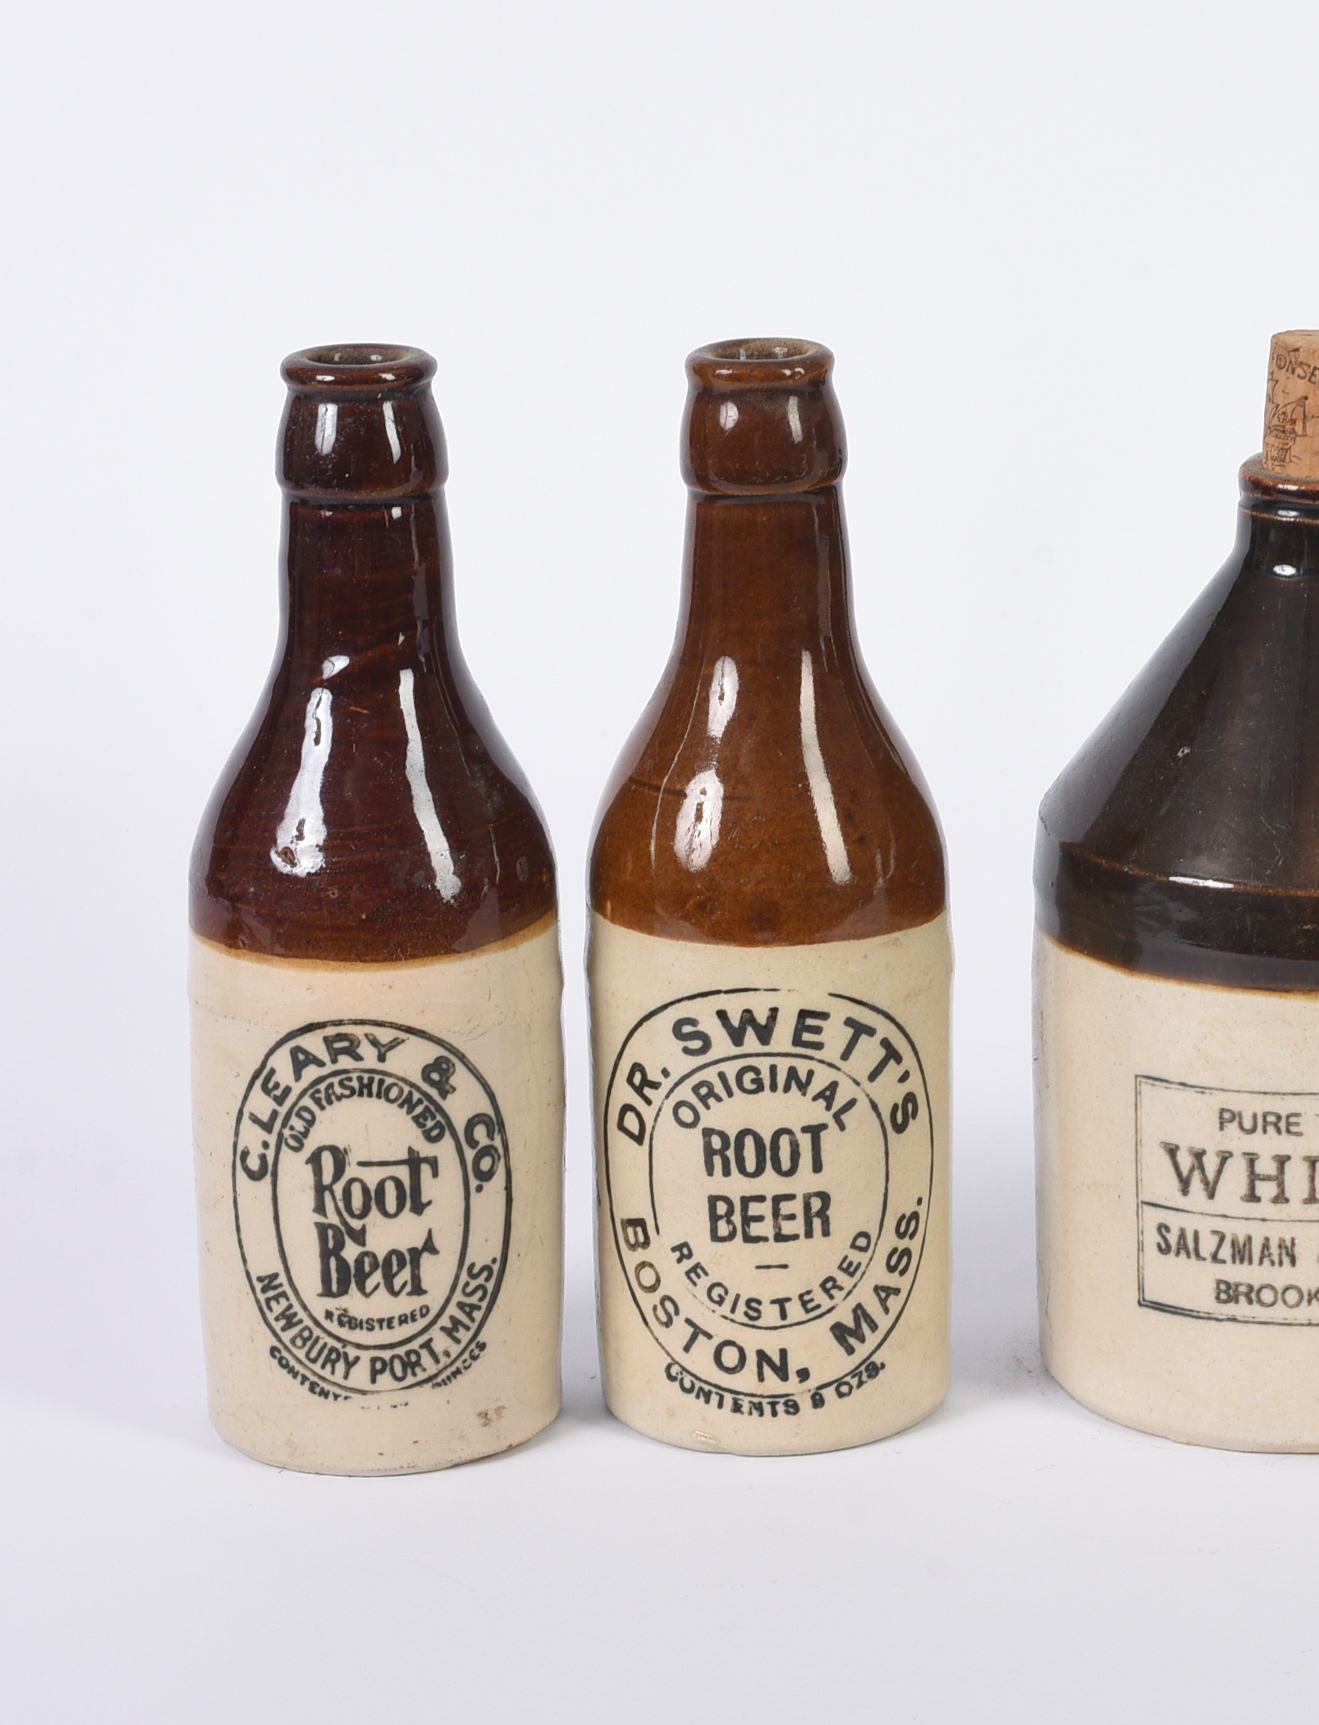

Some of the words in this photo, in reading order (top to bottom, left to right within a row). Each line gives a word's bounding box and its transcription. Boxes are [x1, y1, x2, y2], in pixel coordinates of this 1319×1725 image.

[282, 1108, 317, 1153] OLD
[312, 1075, 448, 1144] FASHIONED
[616, 1062, 672, 1147] DR.
[671, 1007, 919, 1136] SWETT'S
[672, 1064, 858, 1132] ORIGINAL
[421, 1055, 458, 1101] &
[464, 1112, 502, 1194] CO.
[701, 1122, 830, 1179] ROOT
[1218, 1106, 1304, 1137] PURE
[305, 1144, 440, 1248] Root
[707, 1191, 832, 1244] BEER
[313, 1221, 440, 1299] Beer
[670, 1230, 872, 1322] REGISTERED
[1155, 1221, 1298, 1269] SALZMAN
[256, 1272, 361, 1381] NEWBURY
[440, 1256, 499, 1346] MASS.
[323, 1304, 431, 1332] REGISTERED
[620, 1217, 811, 1384] BOSTON,
[829, 1196, 924, 1357] MASS.
[664, 1361, 801, 1418] CONTENTS
